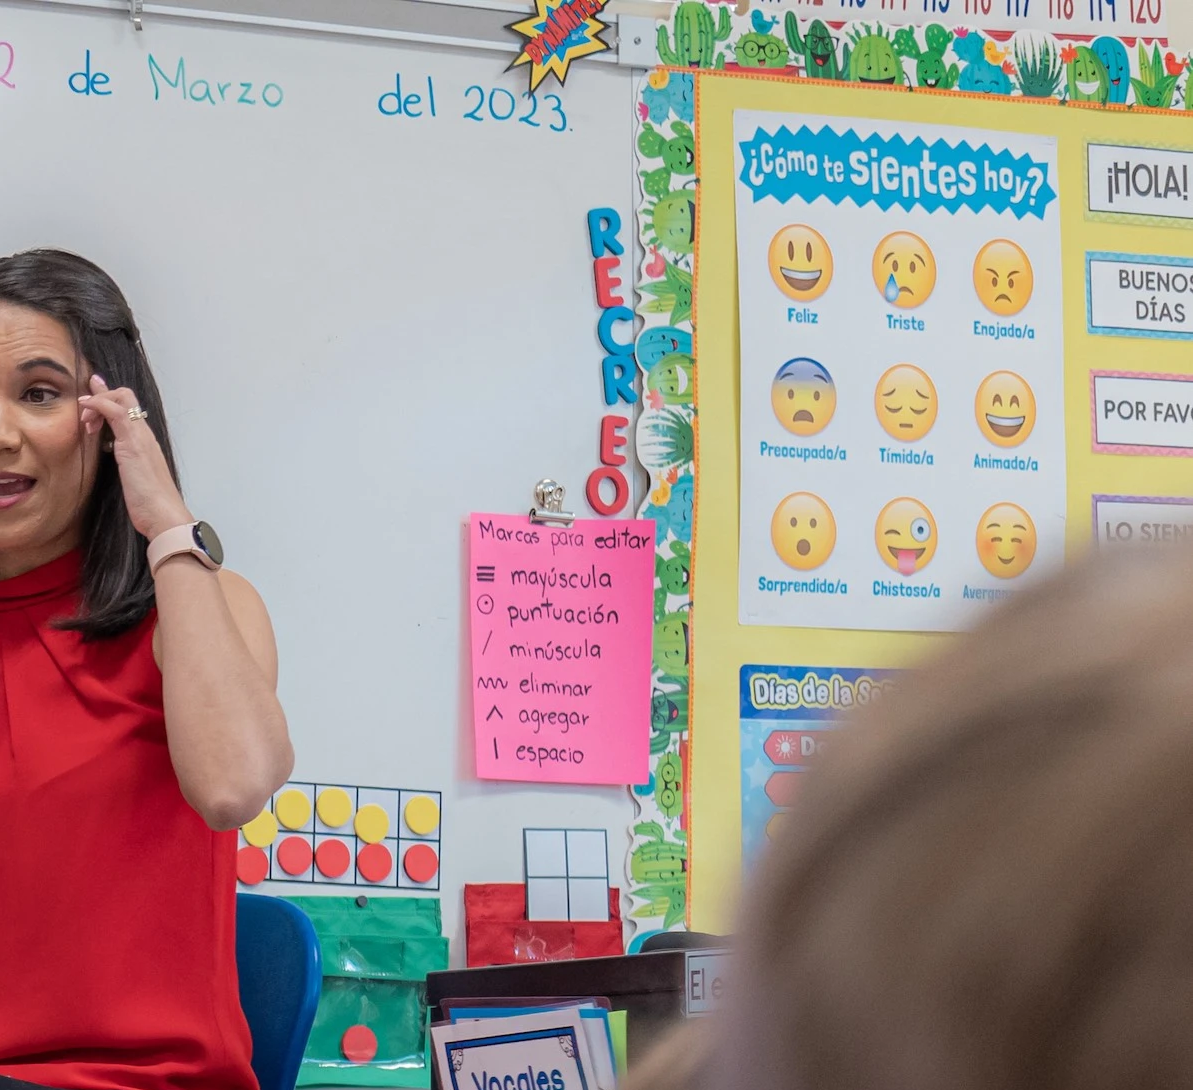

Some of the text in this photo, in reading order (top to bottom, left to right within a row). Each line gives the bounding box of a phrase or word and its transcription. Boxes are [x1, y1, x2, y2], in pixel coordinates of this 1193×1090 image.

[68, 49, 113, 97] de
[147, 53, 285, 108] Marzo
[377, 73, 437, 119] del
[749, 143, 1044, 206] ¿Cómo te sientes hoy?
[1107, 160, 1188, 203] ¡HOLA!
[787, 308, 818, 324] Feliz
[1136, 296, 1186, 323] DÍAS
[886, 314, 925, 332] Triste
[973, 321, 1035, 340] Enojado/a
[587, 207, 638, 517] RECREO
[1104, 399, 1193, 424] POR FAV
[759, 441, 847, 463] Preocupado/a
[879, 447, 934, 466] Tímido/a
[973, 454, 1039, 472] Animado/a
[479, 520, 651, 556] Marcas para editar
[1105, 521, 1133, 542] LO
[510, 564, 613, 598] mayúscula
[757, 577, 848, 597] Sorprendido/a
[872, 580, 941, 599] Chistoso/a
[507, 598, 619, 628] puntuación
[509, 639, 602, 660] minúscula
[519, 672, 593, 697] eliminar
[754, 677, 800, 705] Días
[802, 675, 829, 705] de
[832, 677, 855, 707] la
[519, 708, 590, 733] agregar
[516, 744, 585, 768] espacio
